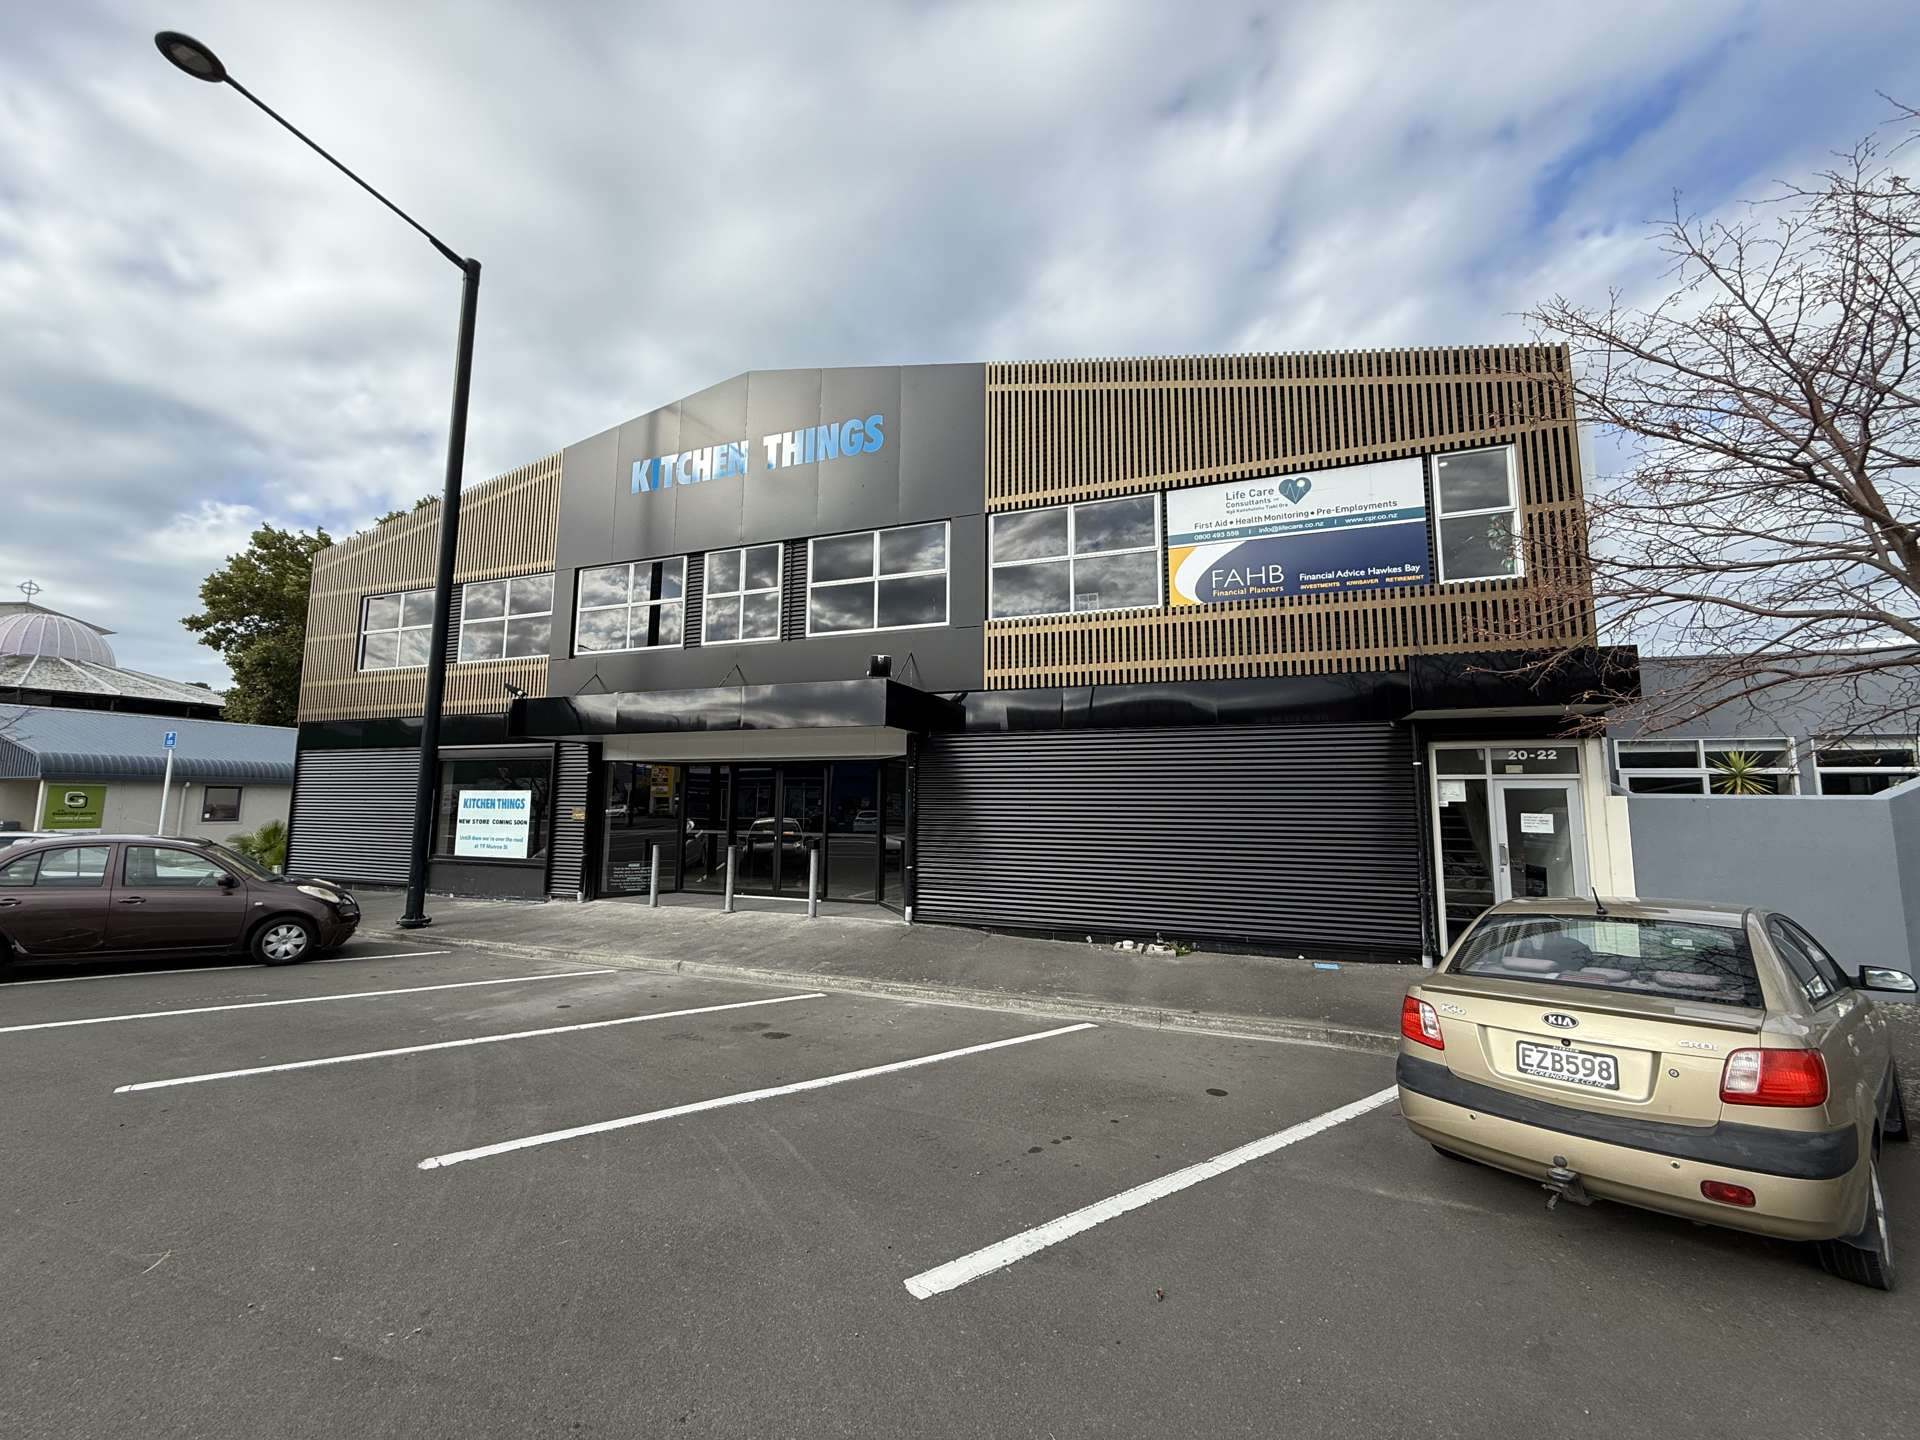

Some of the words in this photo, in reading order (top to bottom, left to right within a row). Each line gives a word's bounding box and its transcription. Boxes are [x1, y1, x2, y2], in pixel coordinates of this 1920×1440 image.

[631, 440, 749, 495] KITCHEN
[762, 414, 885, 471] THINGS
[1225, 491, 1246, 501] Life
[1249, 488, 1275, 498] Care
[1225, 498, 1272, 509] Consultants
[1194, 521, 1213, 530] First
[1214, 519, 1228, 528] Aid
[1235, 515, 1263, 525] Health
[1264, 511, 1309, 522] Monitoring
[1316, 500, 1398, 515] Pre-Employments
[1194, 533, 1211, 541] 0800
[1344, 513, 1398, 524] www.cpr.co.nz
[1212, 564, 1284, 589] FAHB
[1299, 571, 1335, 581] Financial
[1336, 569, 1366, 578] Advice
[1368, 565, 1402, 576] Hawkes
[1404, 563, 1421, 574] Bay
[1300, 581, 1340, 590] INVESTMENTS
[1346, 578, 1379, 586] KIWISAVER
[1385, 574, 1425, 583] RETIREMENT
[1212, 587, 1247, 597] Financial
[1249, 585, 1284, 594] Planners
[1508, 750, 1557, 760] 20-22
[463, 798, 496, 809] KITCHEN
[497, 798, 526, 810] THINGS
[1548, 1014, 1573, 1027] KIA
[1521, 1046, 1612, 1081] EZB598
